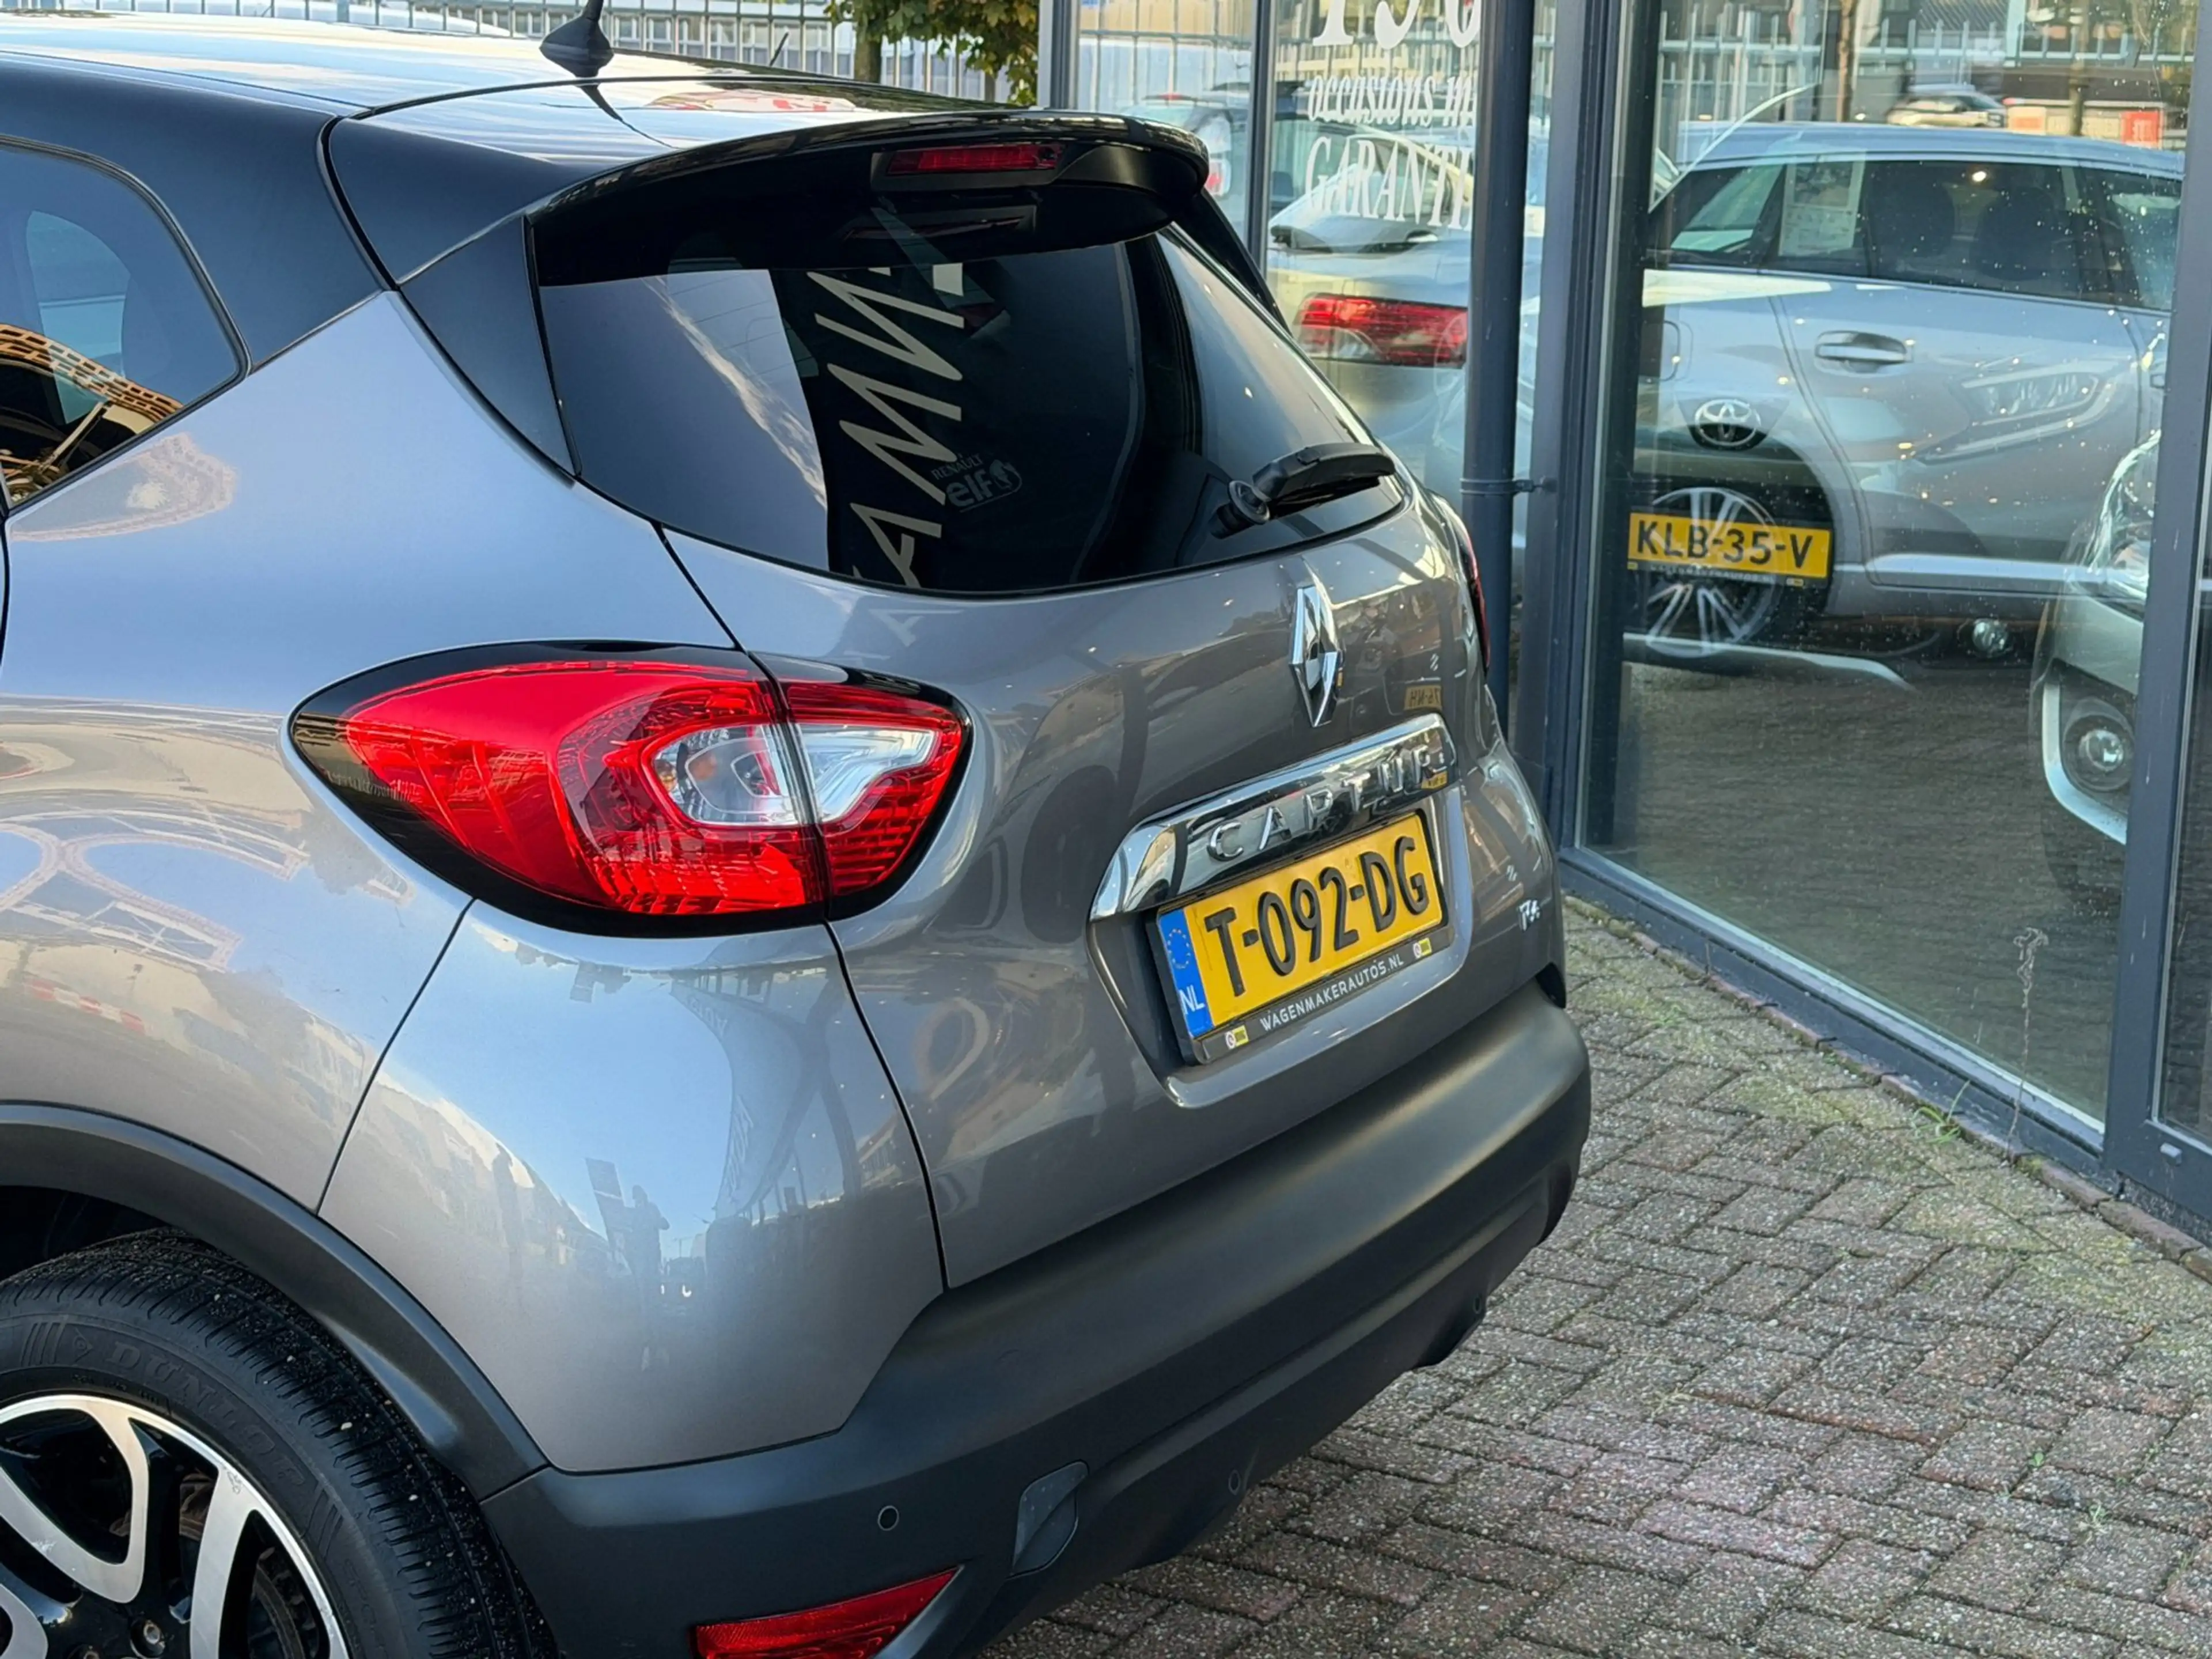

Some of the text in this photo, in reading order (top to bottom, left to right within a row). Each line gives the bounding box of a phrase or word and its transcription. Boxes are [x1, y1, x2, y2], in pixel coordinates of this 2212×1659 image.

[1308, 75, 1436, 127] occasions
[1305, 136, 1474, 229] GARANTI
[946, 468, 993, 507] elf
[1637, 520, 1813, 569] KLB-35-V
[1207, 744, 1435, 861] CAPTUR
[1204, 835, 1430, 997] T-092-DG
[1179, 988, 1205, 1015] NL
[1259, 953, 1404, 1032] WAGENMAKERAUTOS.NL
[105, 1335, 306, 1486] DUNLOP
